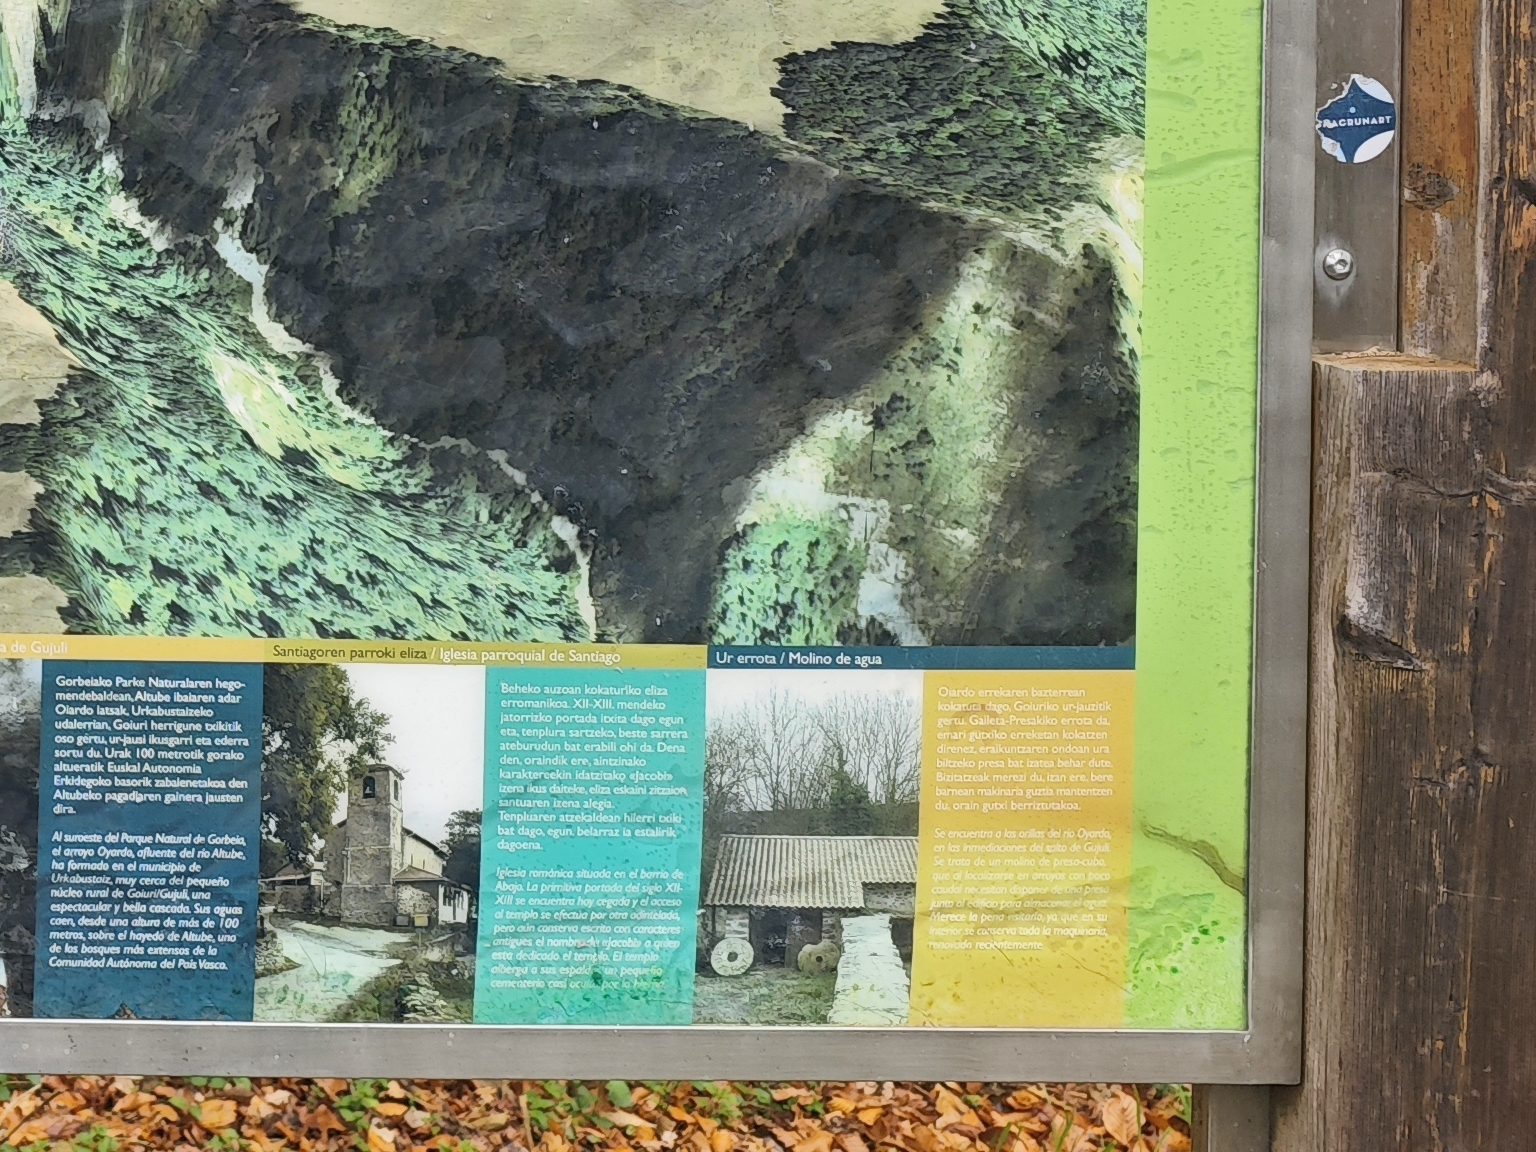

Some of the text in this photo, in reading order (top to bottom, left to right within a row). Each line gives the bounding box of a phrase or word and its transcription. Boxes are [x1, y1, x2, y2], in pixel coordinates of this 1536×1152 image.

[11, 641, 26, 653] de
[30, 642, 68, 654] Gujuli
[273, 645, 345, 659] Santiagoren
[350, 647, 395, 661] parroki
[400, 648, 427, 659] eliza
[440, 649, 477, 663] Iglesia
[481, 649, 545, 664] parroquial
[550, 651, 565, 661] de
[568, 651, 621, 665] Santiago
[716, 652, 733, 664] Ur
[737, 655, 776, 664] errota
[789, 653, 832, 665] Molino
[836, 653, 851, 665] de
[855, 655, 882, 667] agua
[55, 676, 246, 691] Gorbeiako Parke Naturalaren hego-
[501, 683, 668, 696] Beheko auzoan kokaturiko eliza
